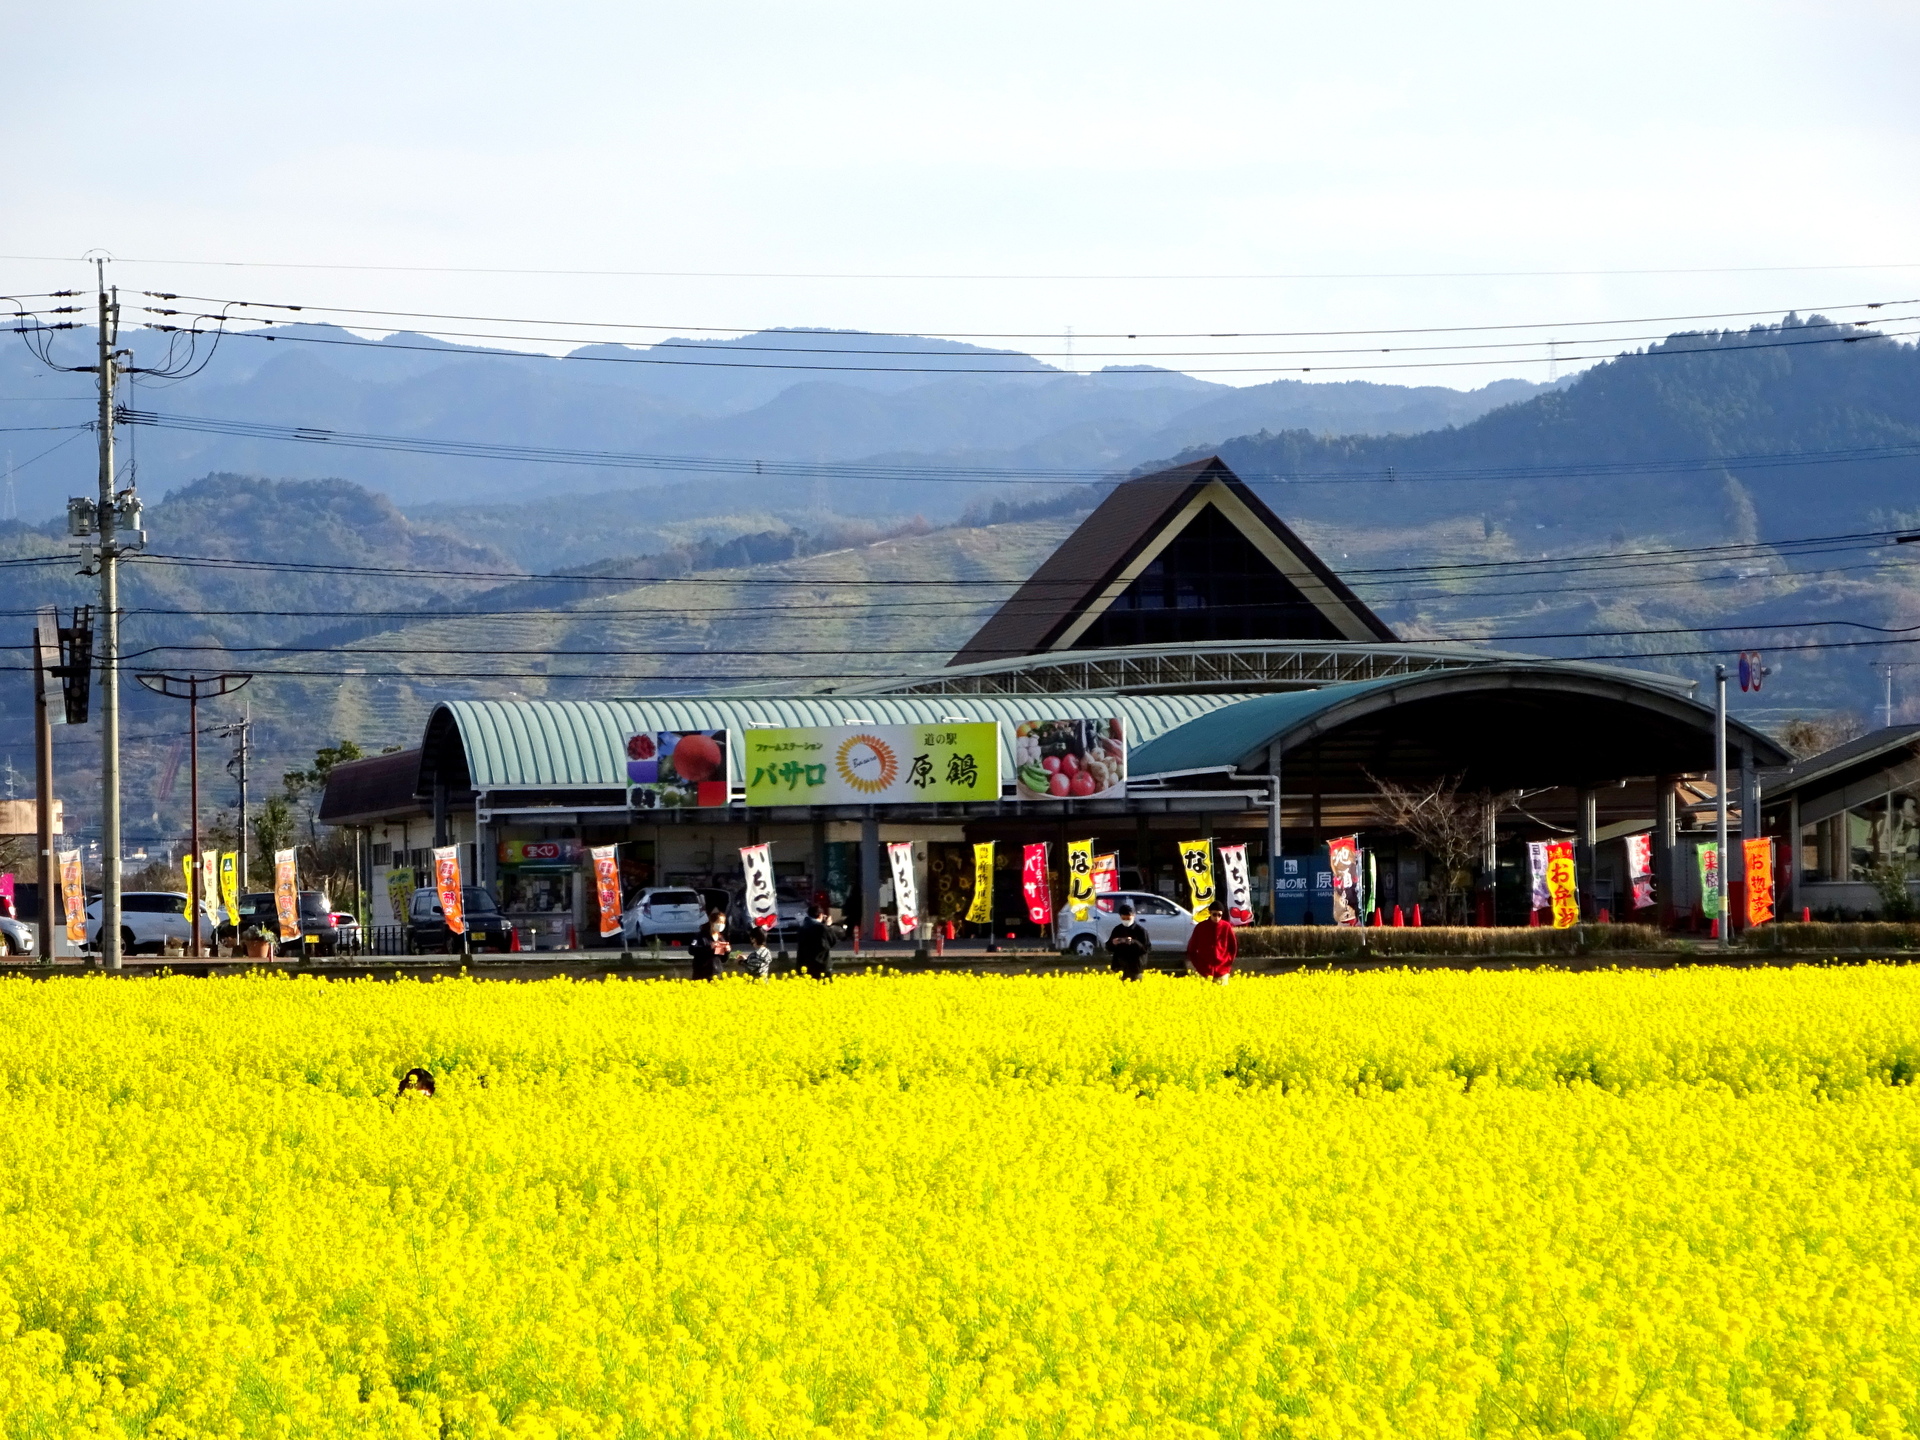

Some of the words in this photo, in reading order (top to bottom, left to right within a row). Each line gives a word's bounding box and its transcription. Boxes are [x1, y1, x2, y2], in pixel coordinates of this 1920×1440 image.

[755, 741, 824, 753] ファームステーション
[924, 732, 957, 747] 道の駅
[751, 759, 827, 791] バサロ
[905, 753, 978, 790] 原鶴
[527, 846, 555, 857] 宝くじ
[1070, 850, 1093, 901] なし
[1184, 850, 1214, 901] なし
[747, 852, 771, 913] いちご
[895, 851, 912, 911] いちご
[1225, 851, 1246, 906] いちご
[1276, 878, 1307, 890] 道の駅
[1551, 863, 1574, 927] お弁当
[1751, 854, 1766, 913] お惣菜
